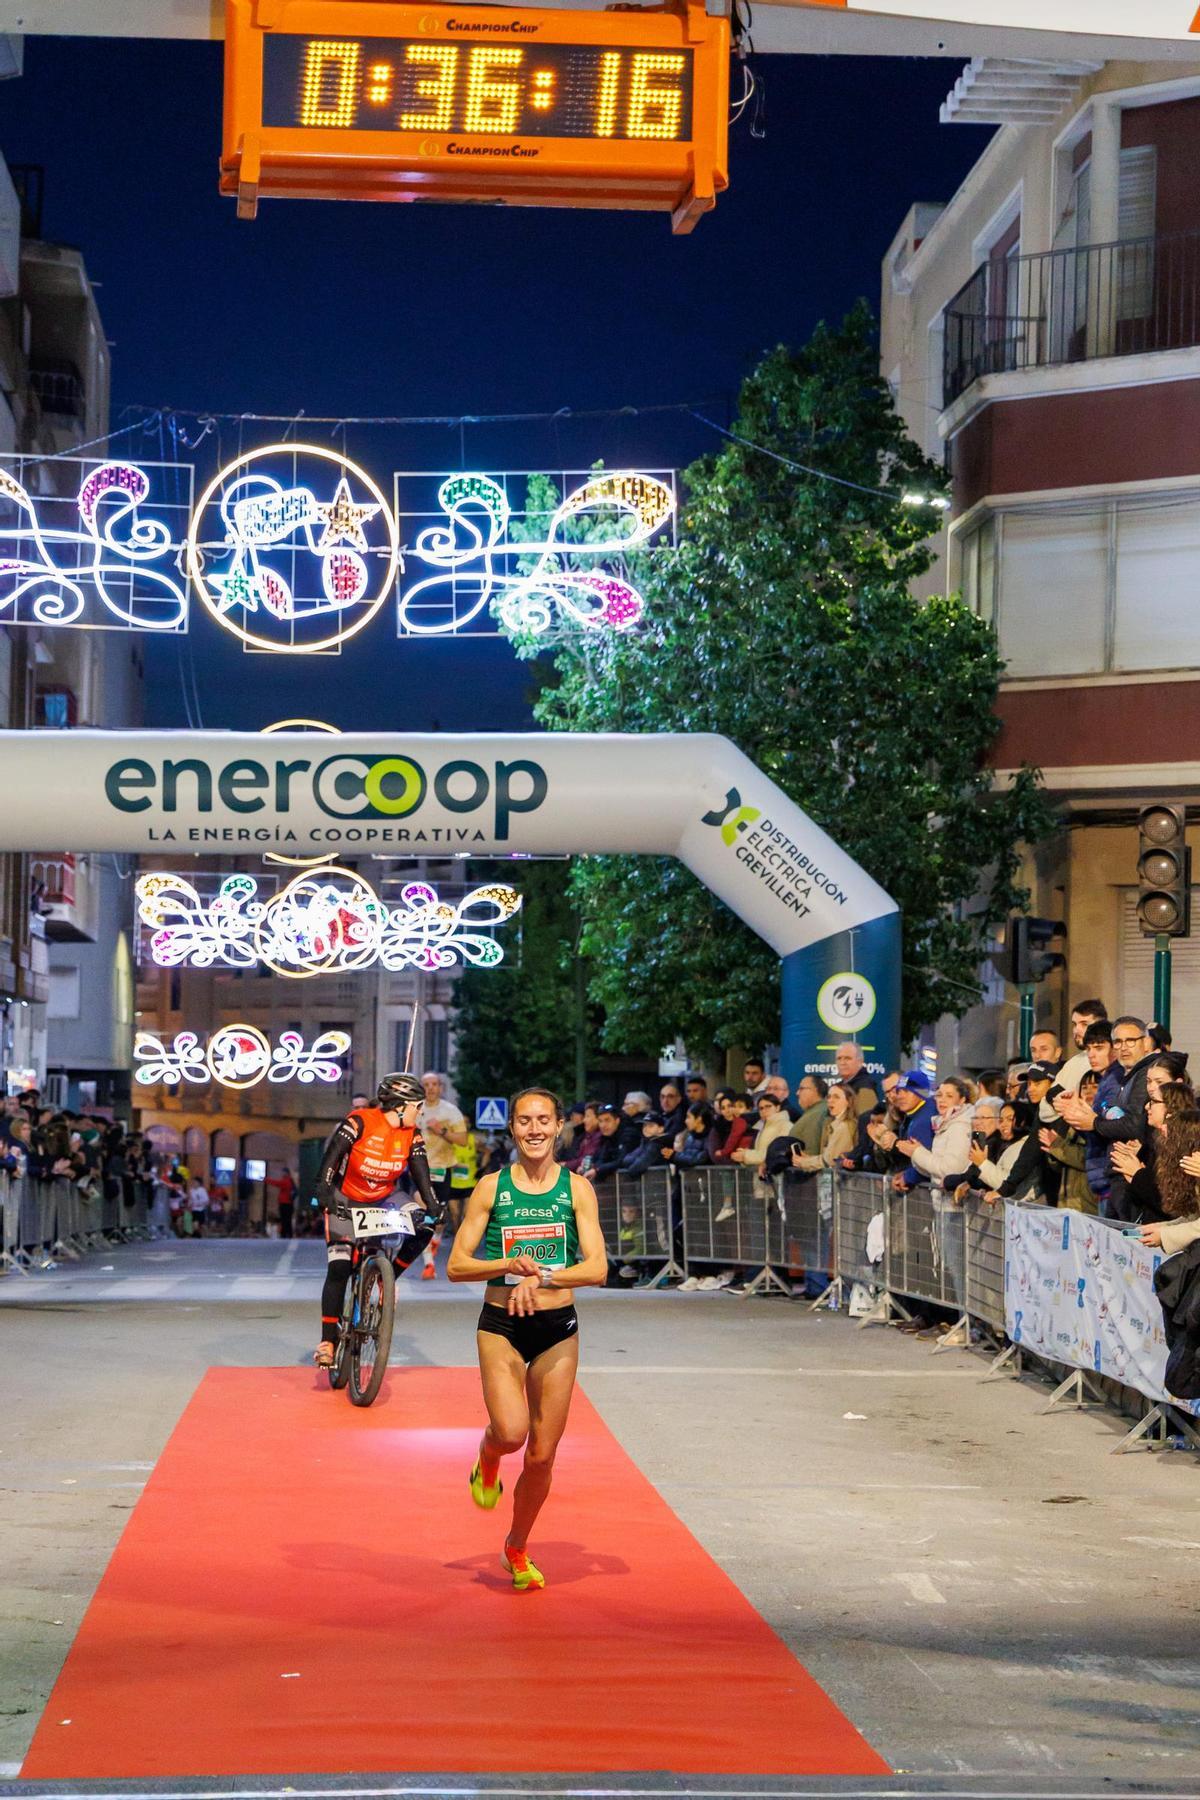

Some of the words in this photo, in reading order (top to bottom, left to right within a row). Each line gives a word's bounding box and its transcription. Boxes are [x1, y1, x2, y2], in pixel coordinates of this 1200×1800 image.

[104, 753, 549, 841] enercoop
[148, 828, 177, 841] LA
[189, 825, 297, 841] ENERGÍA
[310, 828, 485, 842] COOPERATIVA
[747, 832, 813, 899] ELÉCTRICA
[760, 819, 848, 905] DISTRIBUCIÓN
[736, 846, 811, 918] CREVILLENT
[513, 1243, 557, 1260] 2002
